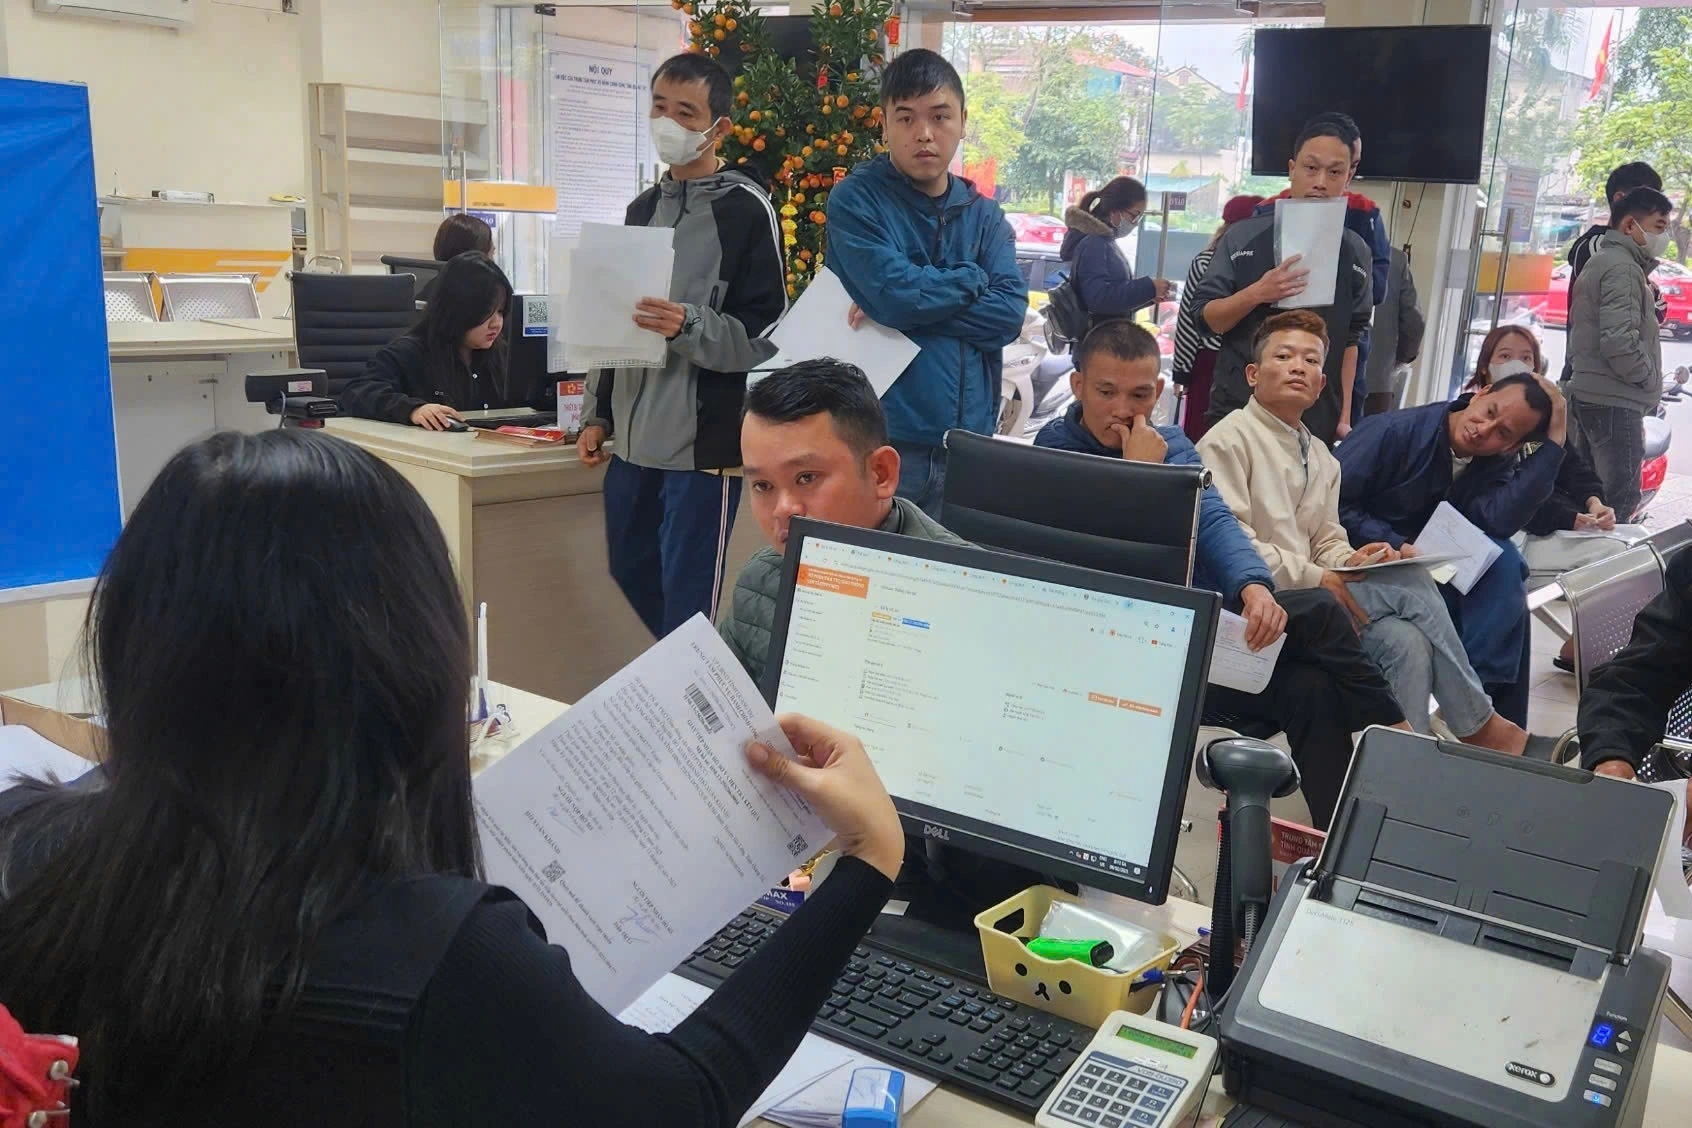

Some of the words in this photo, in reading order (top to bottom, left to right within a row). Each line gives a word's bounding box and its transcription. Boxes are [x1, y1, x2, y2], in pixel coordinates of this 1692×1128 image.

[589, 65, 599, 75] NỘI
[601, 67, 612, 76] QUY
[923, 824, 950, 841] DELL
[1282, 832, 1303, 844] TRUNG
[1305, 837, 1317, 848] TÂM
[1281, 840, 1296, 850] TỈNH
[1509, 1063, 1538, 1078] xerox
